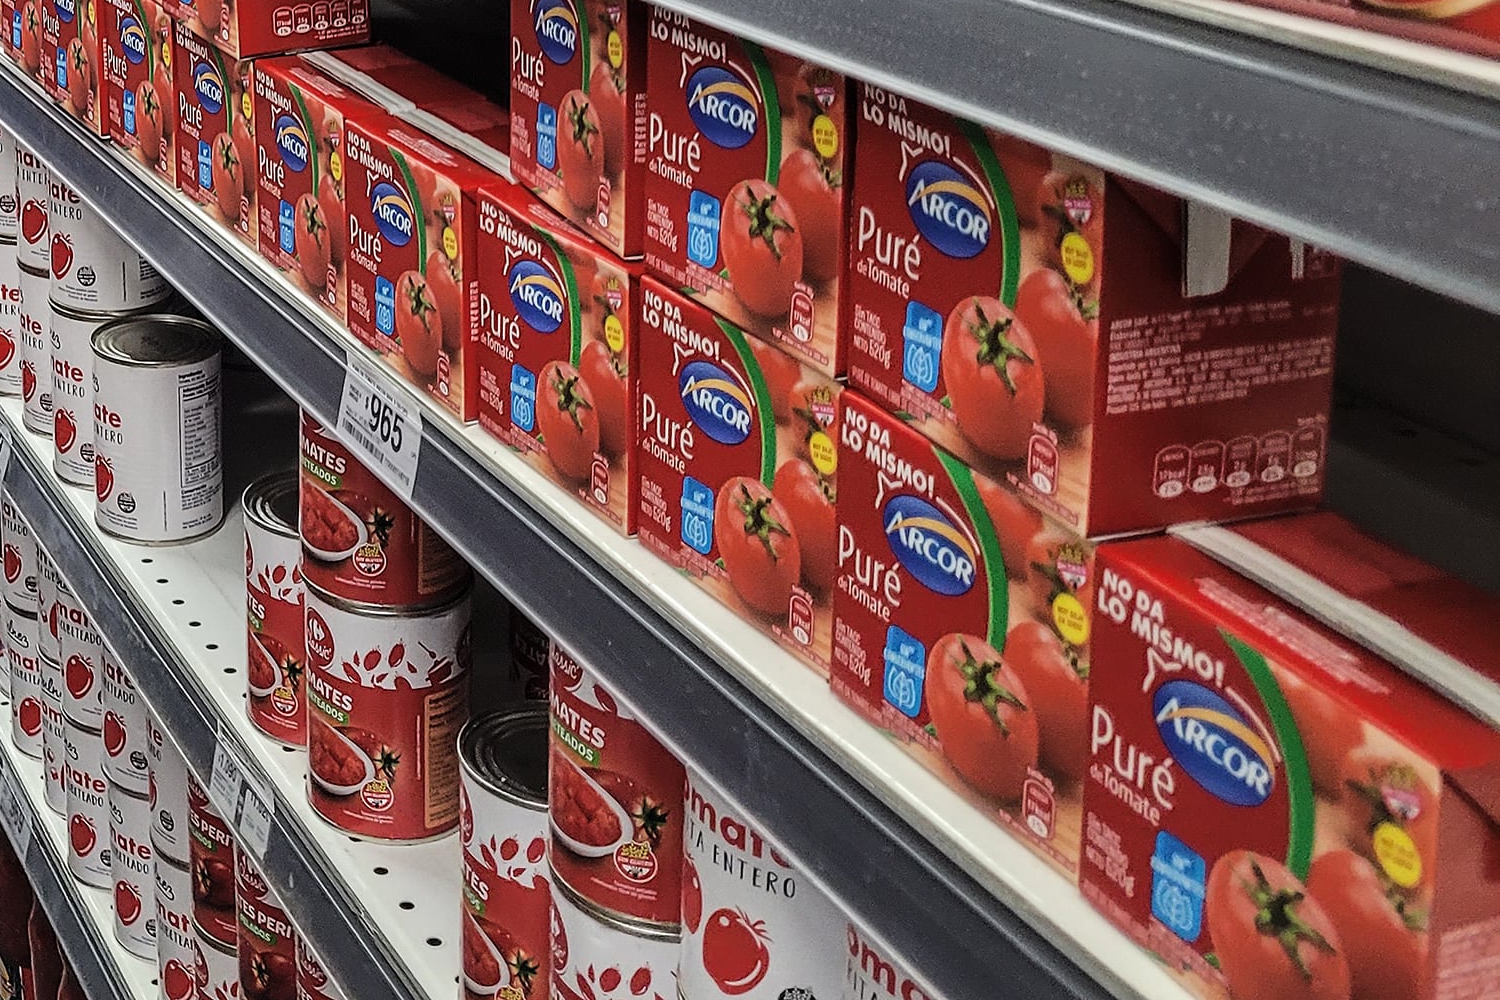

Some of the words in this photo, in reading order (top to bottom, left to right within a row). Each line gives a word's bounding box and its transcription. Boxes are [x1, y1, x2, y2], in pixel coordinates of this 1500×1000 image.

[535, 14, 576, 51] ARCOR
[669, 28, 728, 63] MISMO!
[512, 37, 544, 88] Puré
[687, 87, 756, 135] ARCOR
[862, 101, 886, 126] LO
[887, 112, 954, 159] MISMO!
[259, 145, 284, 188] Puré
[276, 127, 308, 165] ARCOR
[649, 112, 701, 172] Puré
[349, 214, 381, 260] Puré
[372, 195, 413, 237] ARCOR
[908, 177, 990, 246] ARCOR
[857, 206, 923, 280] Puré
[480, 292, 521, 350] Puré
[510, 276, 564, 324] ARCOR
[662, 316, 720, 360] MISMO!
[868, 341, 891, 370] 520g
[643, 394, 694, 460] Puré
[681, 375, 751, 437] ARCOR
[845, 406, 868, 433] NO
[870, 422, 891, 449] DA
[841, 424, 863, 455] LO
[864, 442, 934, 498] MISMO!
[838, 524, 901, 607] Puré
[885, 510, 973, 588] ARCOR
[1102, 568, 1134, 599] NO
[1136, 587, 1165, 621] DA
[1098, 589, 1125, 624] LO
[1131, 613, 1225, 688] MISMO!
[1091, 705, 1176, 811] Puré
[1156, 696, 1270, 797] ARCOR
[712, 848, 797, 899] ENTERO
